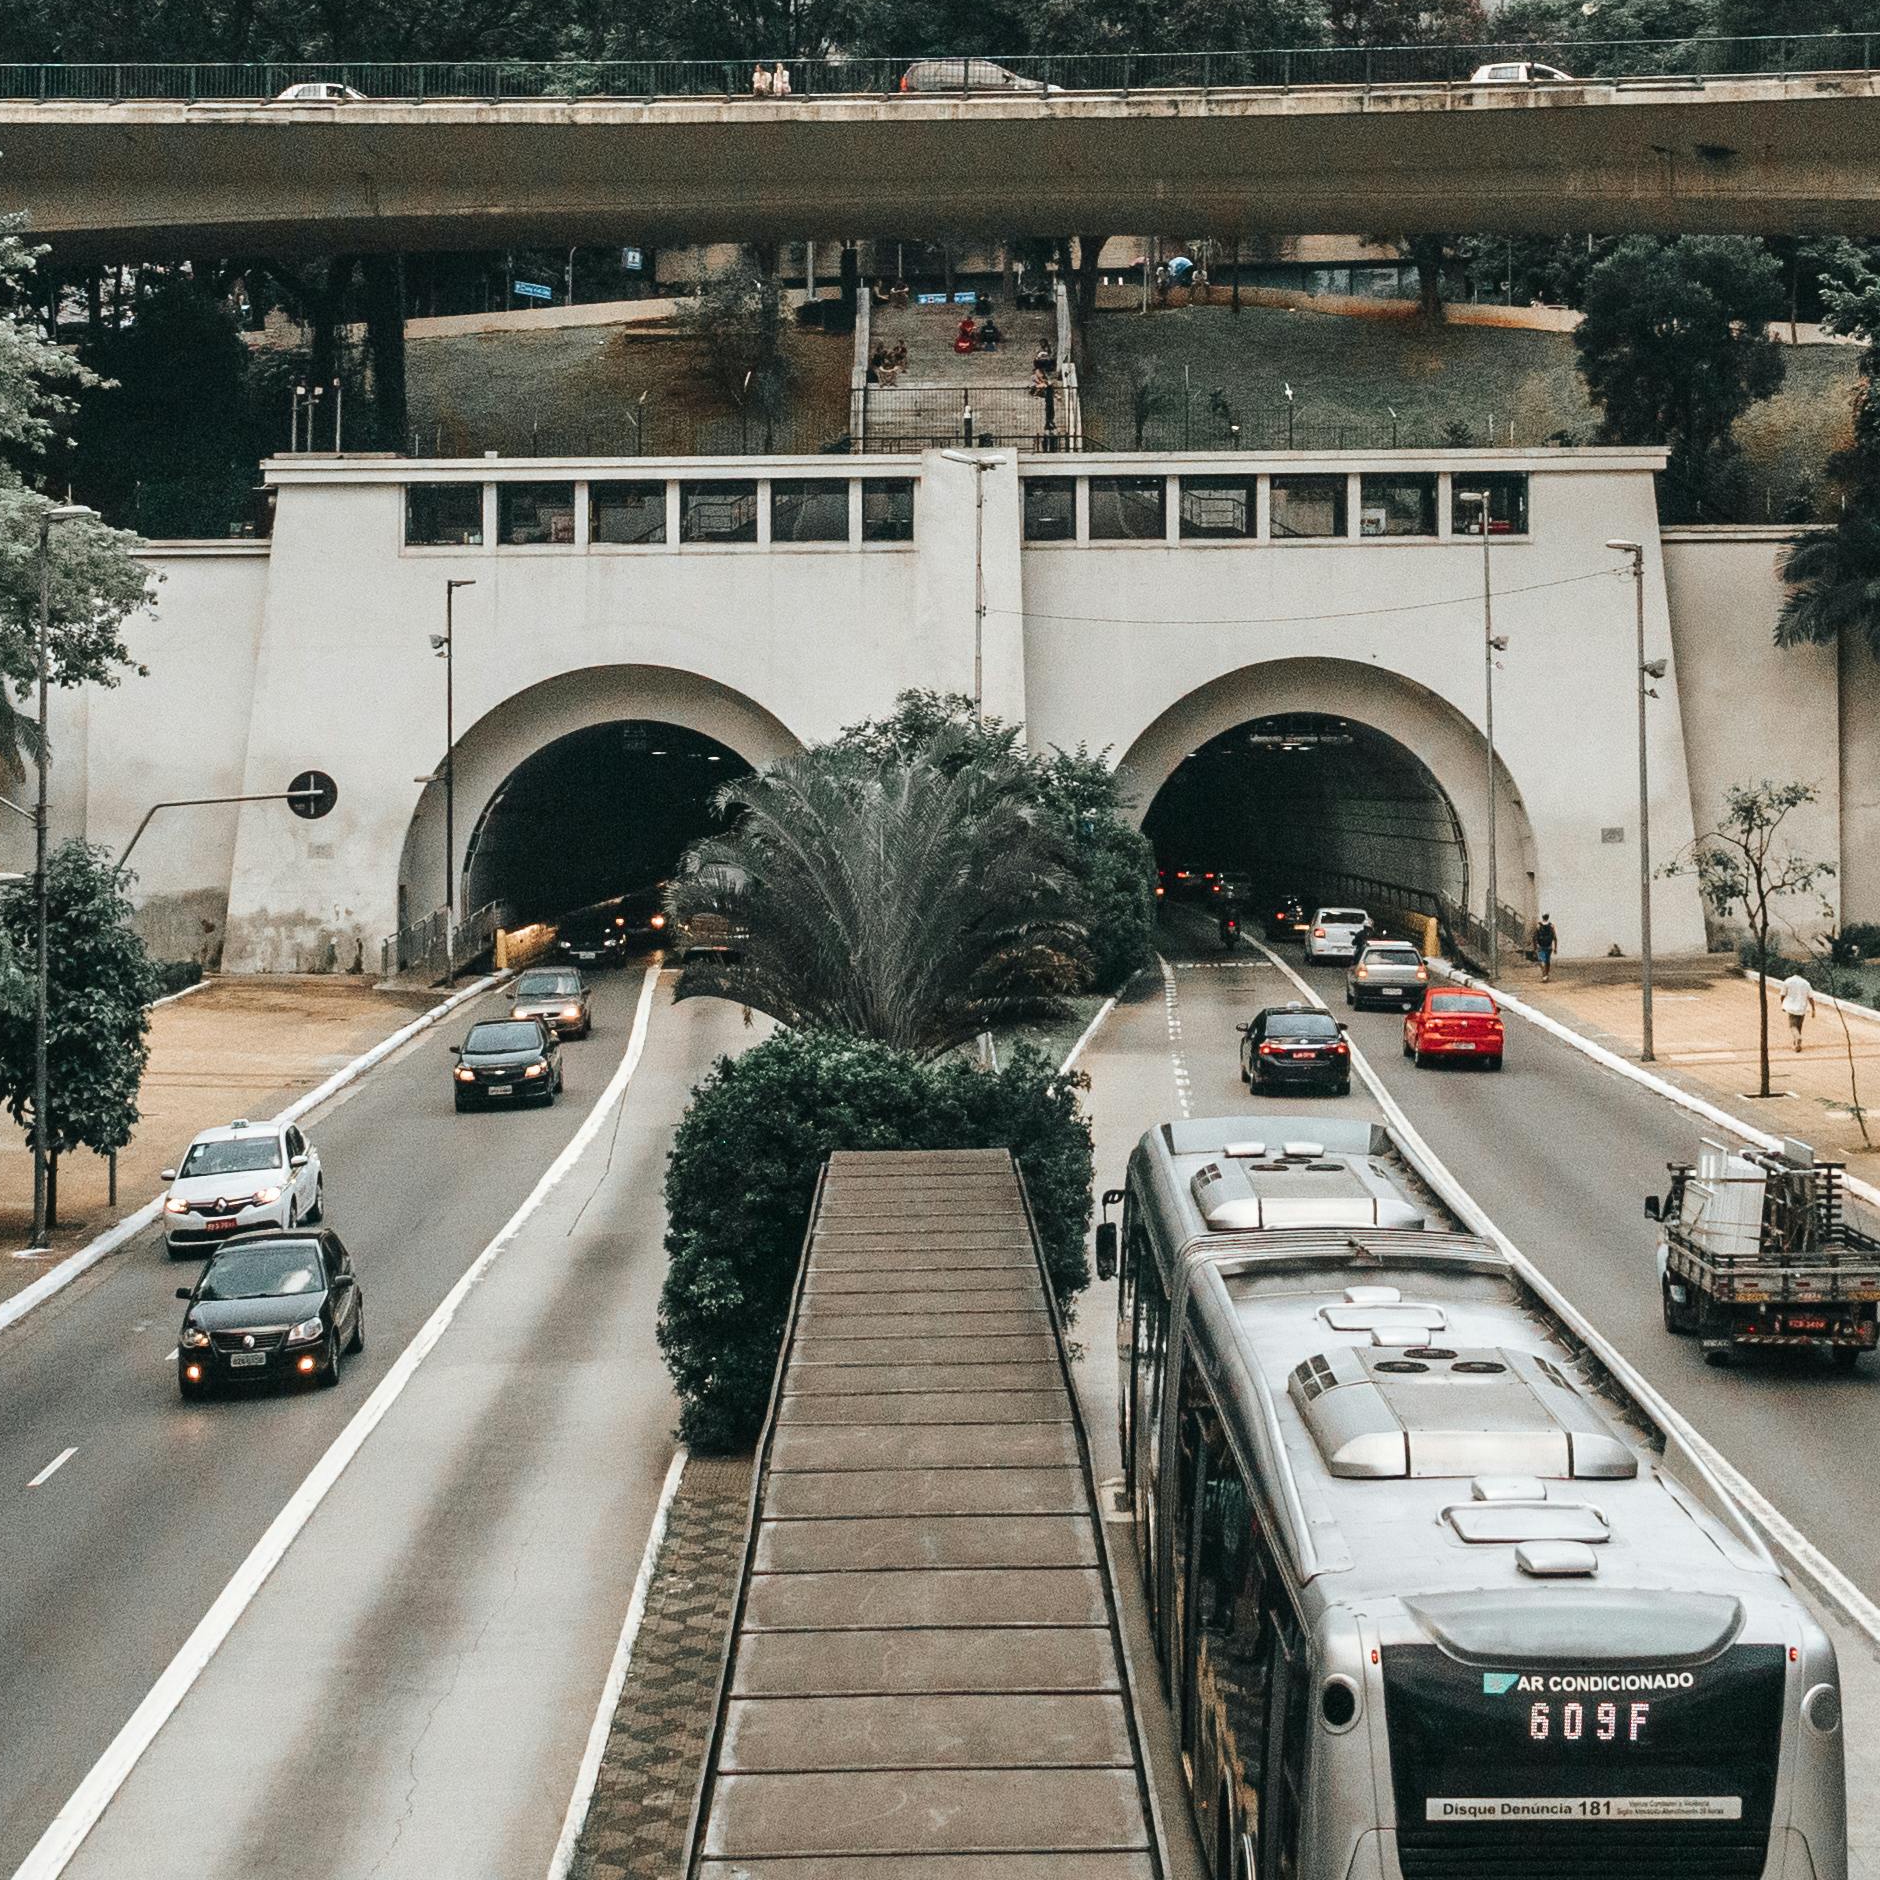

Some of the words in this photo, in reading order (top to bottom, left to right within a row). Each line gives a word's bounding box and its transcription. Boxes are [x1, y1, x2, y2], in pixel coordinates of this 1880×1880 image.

[1517, 1676, 1544, 1691] AR
[1549, 1672, 1694, 1692] CONDICIONADO
[1530, 1702, 1650, 1740] 609F
[1442, 1803, 1496, 1817] Disque
[1500, 1802, 1573, 1815] Denúncia
[1578, 1800, 1612, 1816] 181
